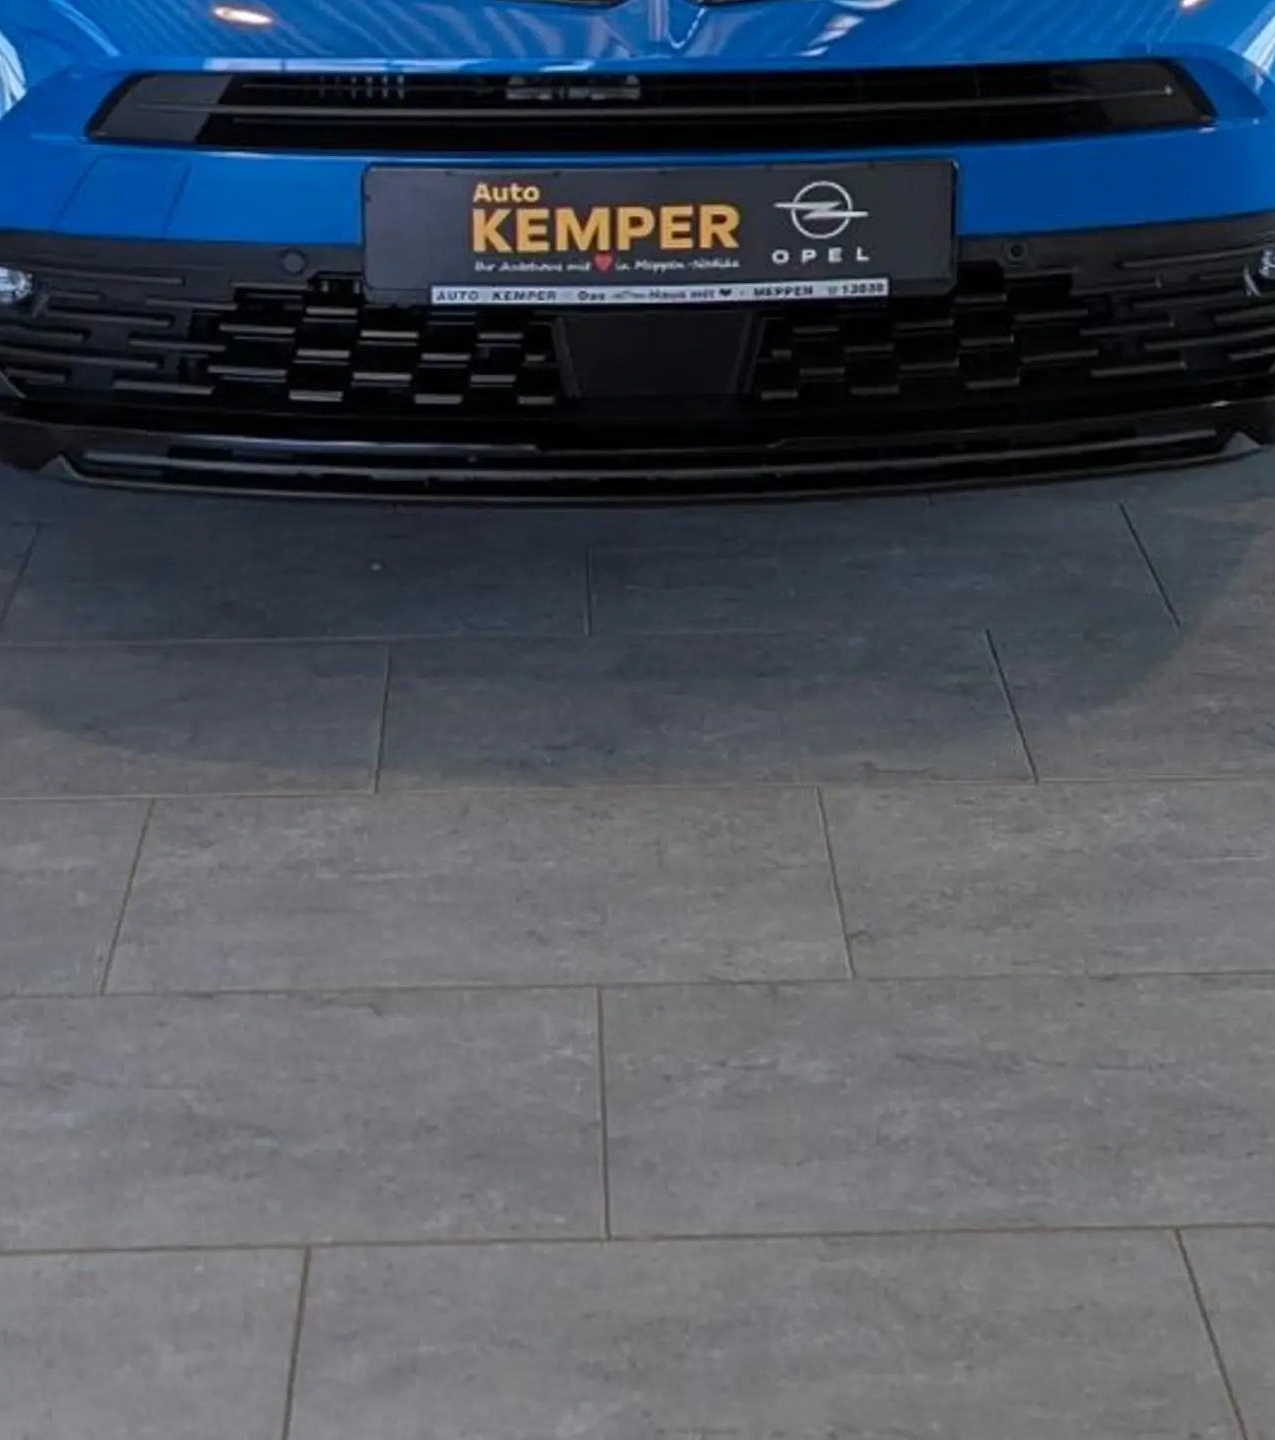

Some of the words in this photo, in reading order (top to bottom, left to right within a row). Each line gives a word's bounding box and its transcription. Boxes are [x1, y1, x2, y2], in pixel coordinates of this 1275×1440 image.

[473, 182, 540, 203] Auto
[472, 205, 741, 253] KEMPER
[771, 246, 870, 264] OPEL
[437, 290, 480, 301] AUTO
[492, 290, 557, 301] KEMPER
